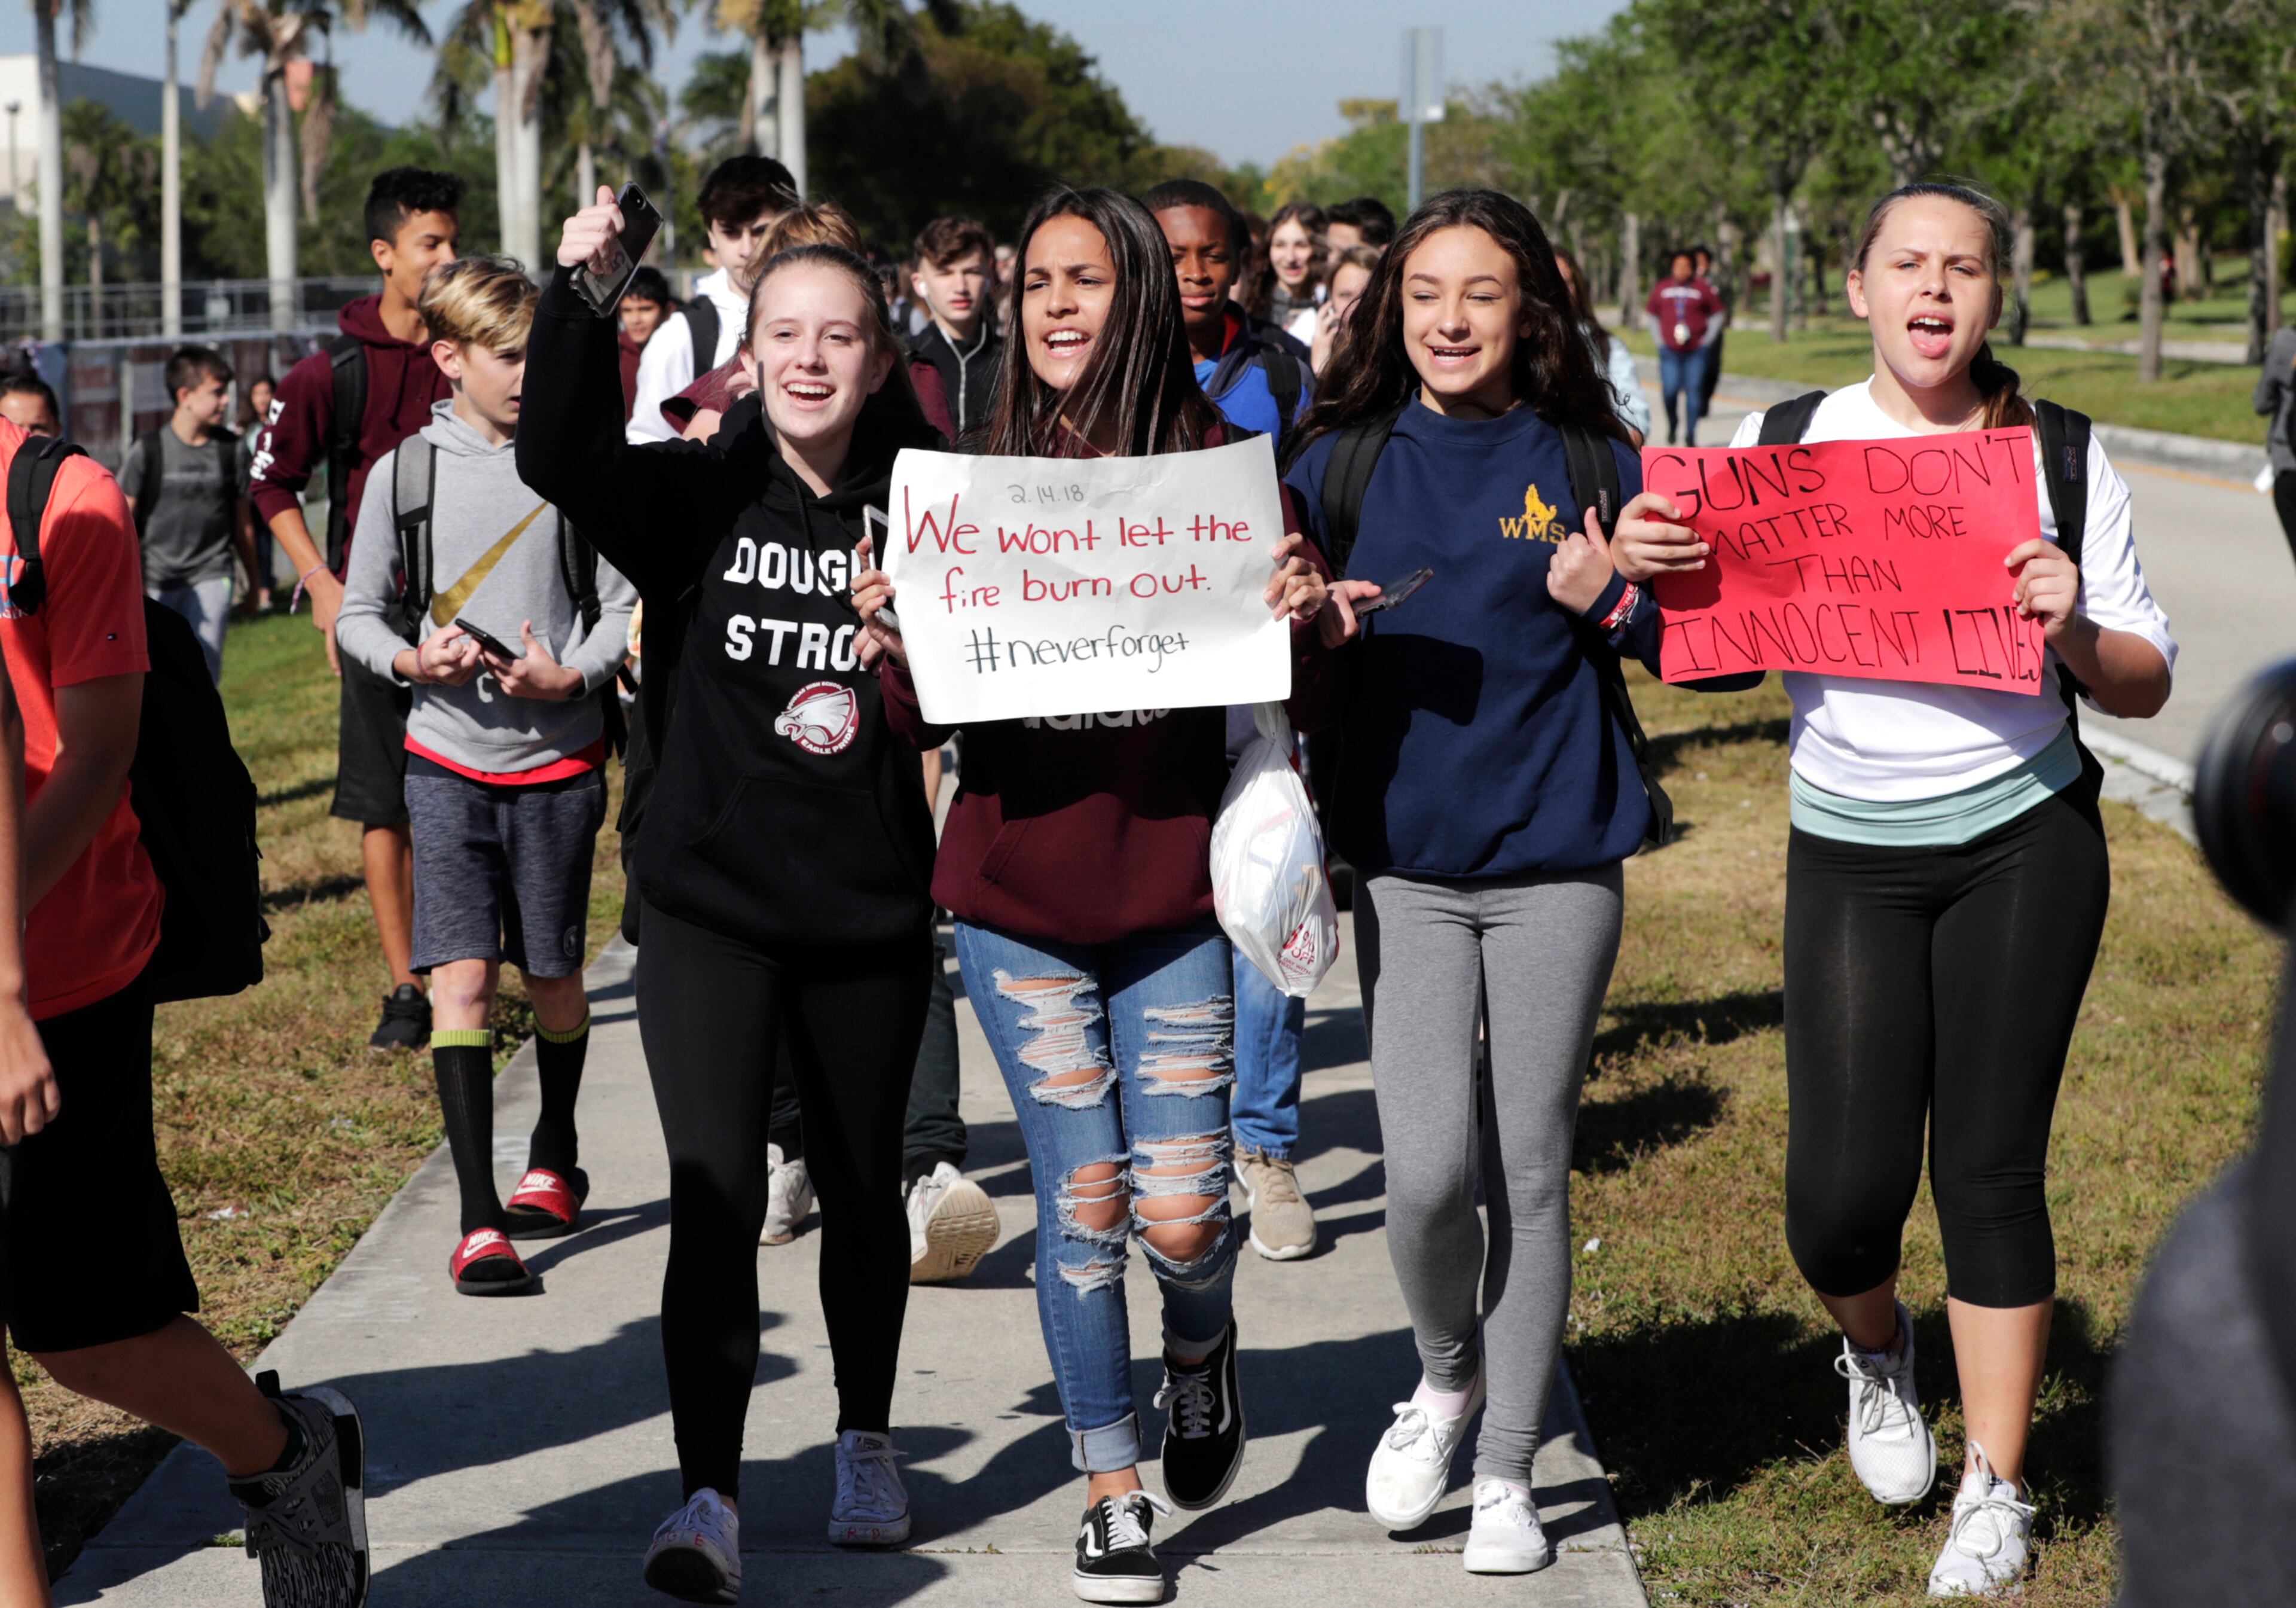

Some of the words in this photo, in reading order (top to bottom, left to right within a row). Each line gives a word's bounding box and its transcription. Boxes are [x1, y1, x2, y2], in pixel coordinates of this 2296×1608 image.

[1009, 484, 1085, 504] 2.14.18
[1647, 448, 1825, 521] GUNS
[1864, 435, 2029, 496] DON'T
[904, 485, 979, 554] We
[998, 520, 1101, 553] wont
[1119, 516, 1174, 547] let
[1187, 514, 1252, 542] the
[1499, 517, 1566, 544] WMS
[1692, 504, 1853, 560] MATTER
[1885, 504, 1968, 540] MORE
[939, 566, 1000, 614] fire
[1022, 569, 1112, 602] burn
[1129, 564, 1211, 599] out.
[1765, 554, 1902, 594] THAN
[725, 614, 868, 672] STRO
[964, 625, 1189, 674] #neverforget
[1663, 603, 1919, 676] INNOCENT
[1943, 605, 2041, 682] LIVES
[800, 739, 832, 754] EAGLE
[832, 725, 855, 752] PRIDE
[523, 1172, 556, 1189] NIKE
[469, 1231, 499, 1247] NIKE
